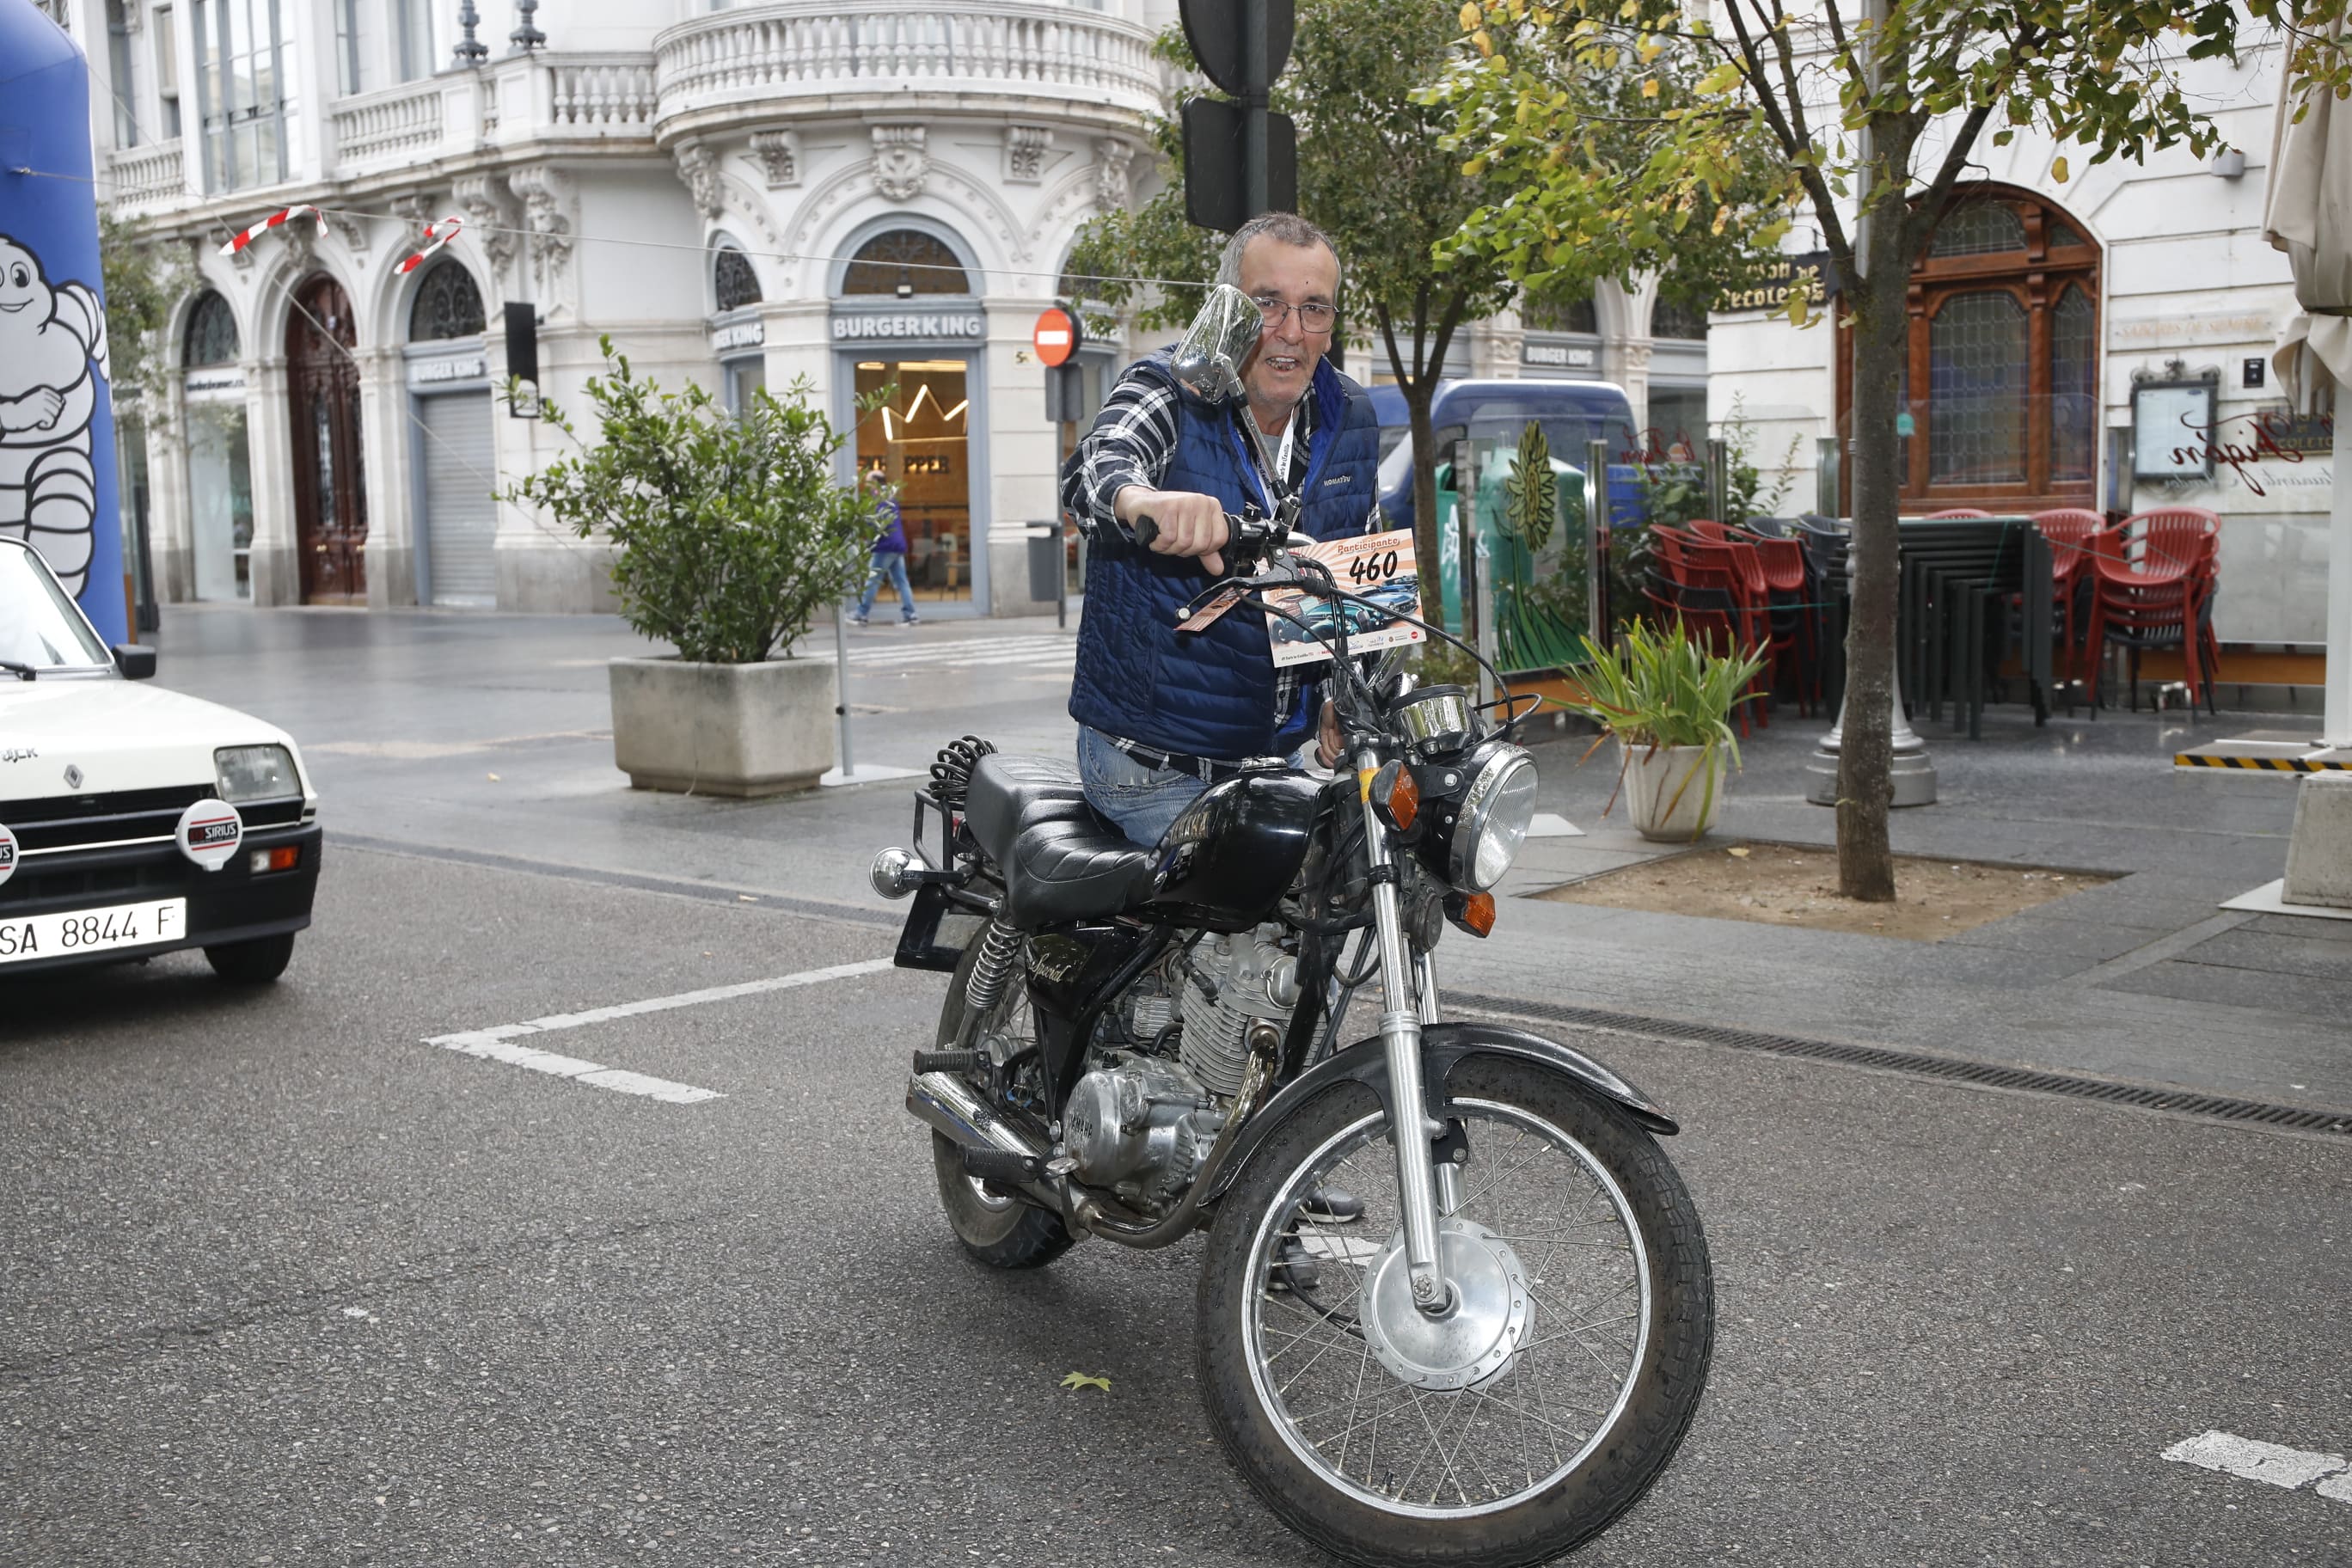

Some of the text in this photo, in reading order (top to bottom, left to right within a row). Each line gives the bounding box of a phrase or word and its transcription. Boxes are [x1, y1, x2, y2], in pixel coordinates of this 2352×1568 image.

[1526, 346, 1593, 365] BURGER KING
[1324, 475, 1351, 487] KOMATSU
[1338, 537, 1399, 554] Participante
[1350, 550, 1398, 585] 460
[205, 824, 236, 839] SIRIUS
[0, 906, 174, 955] SA 8844 F
[1029, 952, 1071, 983] Special
